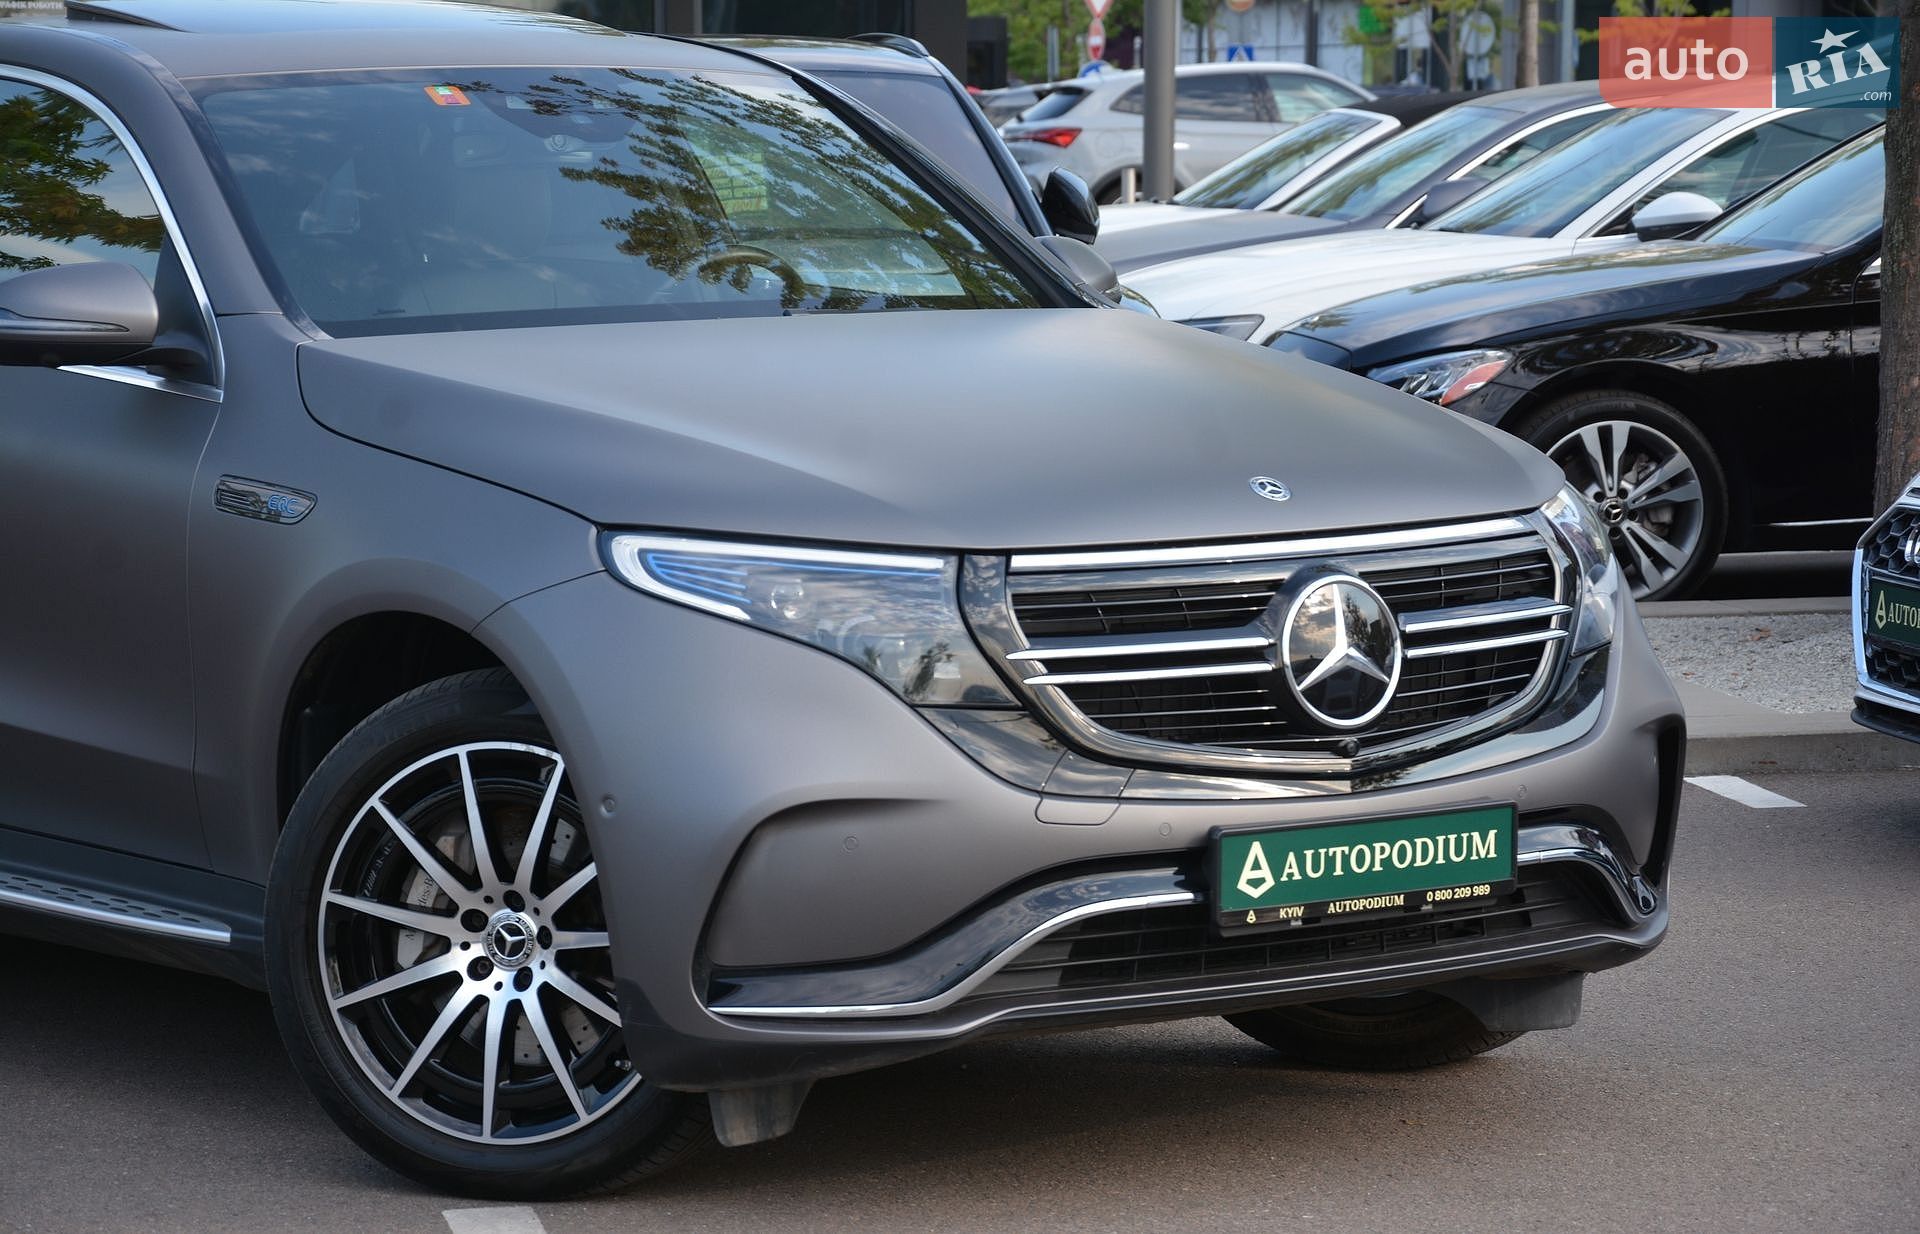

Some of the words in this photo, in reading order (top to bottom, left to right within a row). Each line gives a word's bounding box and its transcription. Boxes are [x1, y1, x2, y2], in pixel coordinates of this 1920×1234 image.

[1280, 829, 1498, 882] AUTOPODIUM
[1426, 892, 1433, 902] 0
[1434, 888, 1453, 901] 800
[1453, 887, 1471, 899] 209
[1472, 884, 1491, 896] 989
[1279, 906, 1305, 919] KYIV
[1327, 894, 1405, 914] AUTOPODIUM
